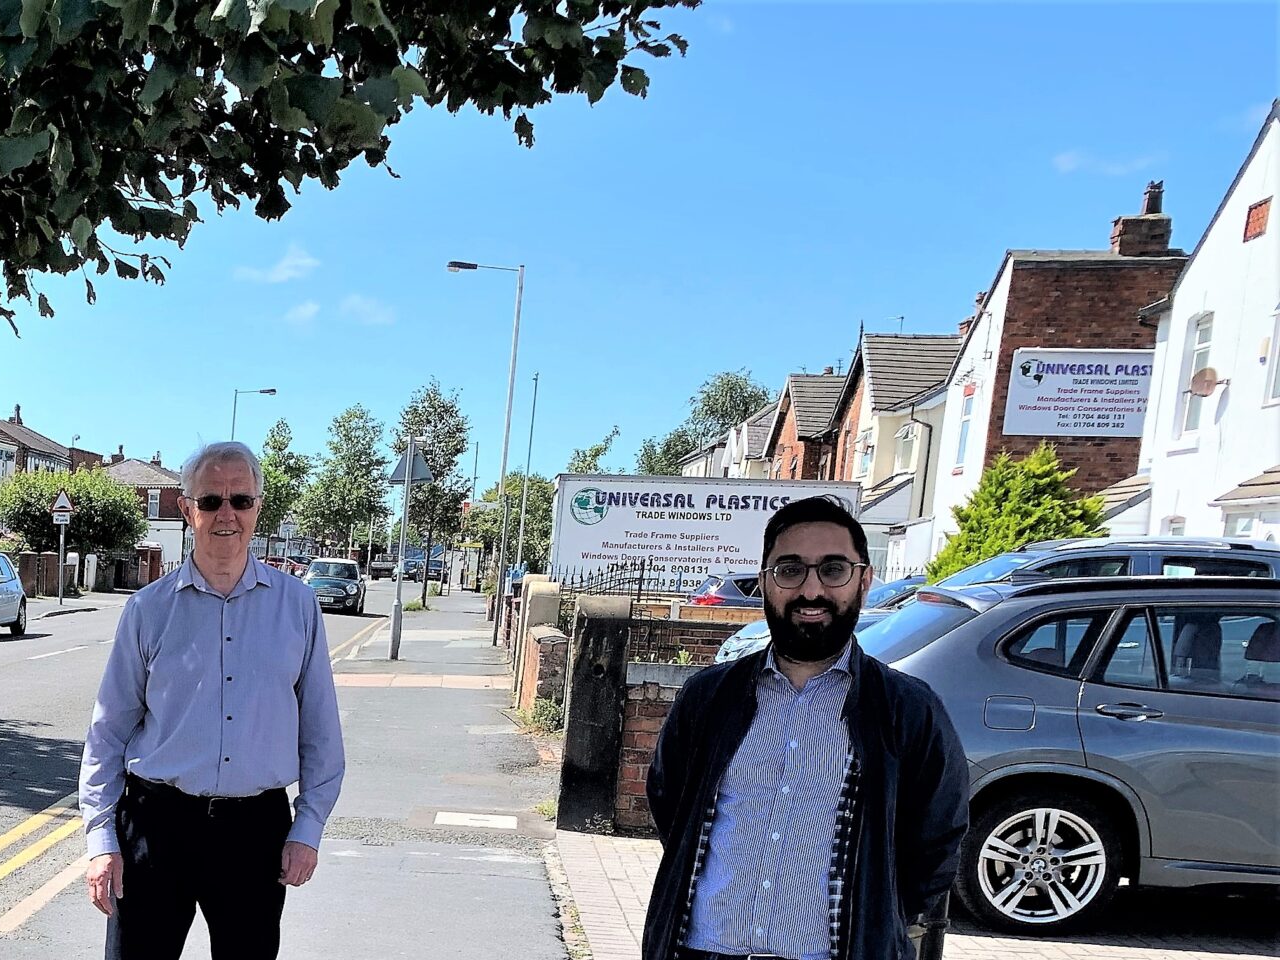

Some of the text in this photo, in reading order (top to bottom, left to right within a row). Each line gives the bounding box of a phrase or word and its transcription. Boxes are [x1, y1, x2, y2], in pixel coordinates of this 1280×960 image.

[1036, 363, 1110, 375] UNIVERSAL
[1106, 388, 1141, 396] Suppliers
[1018, 404, 1052, 412] Windows
[1077, 405, 1135, 413] Conservatories
[594, 491, 791, 511] UNIVERSAL PLASTICS
[635, 510, 733, 522] TRADE WINDOWS LTD
[624, 530, 720, 543] Trade Frame Suppliers
[601, 541, 741, 554] Manufacturers & Installers PVCu
[581, 551, 759, 566] Windows Doors Conservatories & Porches
